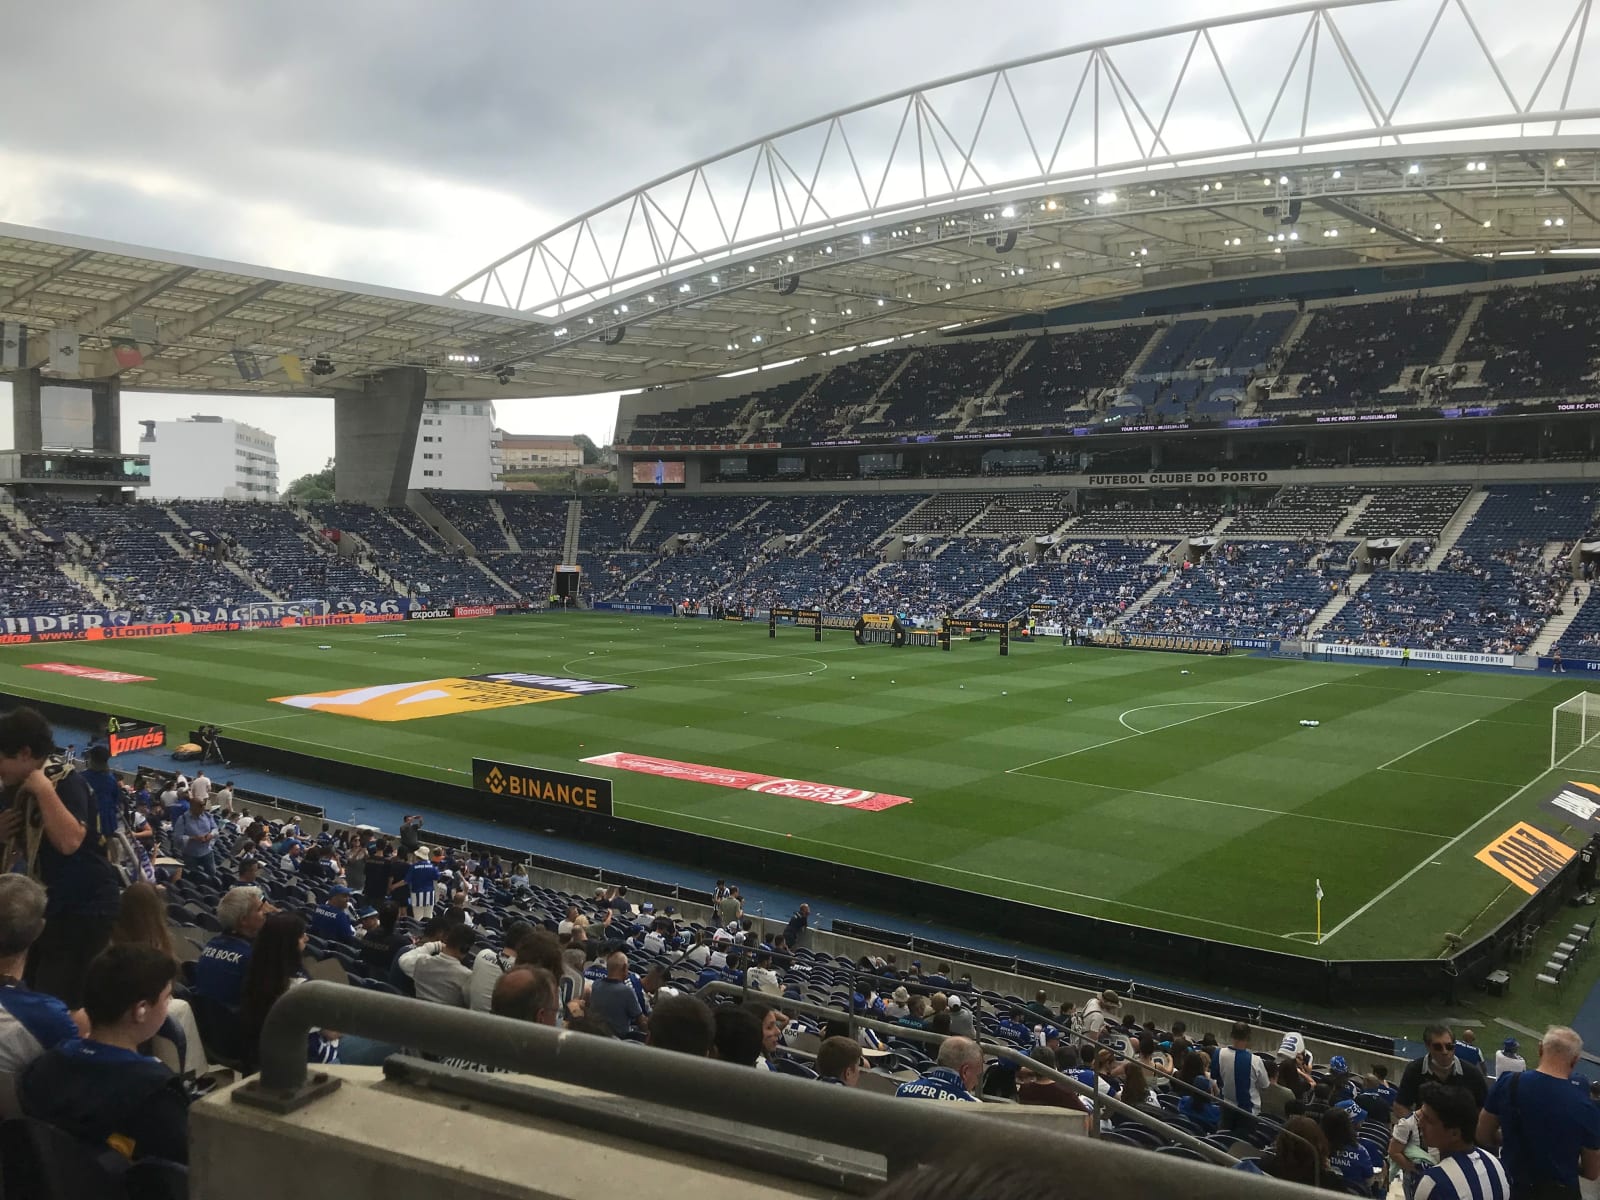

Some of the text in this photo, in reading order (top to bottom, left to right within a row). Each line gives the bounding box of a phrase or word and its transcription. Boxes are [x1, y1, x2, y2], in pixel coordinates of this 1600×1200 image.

[1088, 472, 1268, 485] FUTEBOL CLUBE DO PORTO
[0, 614, 103, 634] UPER
[304, 615, 354, 626] Confort
[115, 625, 177, 637] Confort
[1354, 648, 1373, 656] CLUBE
[1414, 651, 1504, 664] FUTEBOL CLUBE DO PORTO
[510, 776, 597, 808] BINANCE
[765, 787, 848, 801] SUPER
[783, 783, 853, 795] BOCK
[1582, 853, 1590, 862] 10
[324, 909, 337, 919] BOCK
[215, 949, 242, 964] BOCK
[902, 1084, 936, 1098] SUPER
